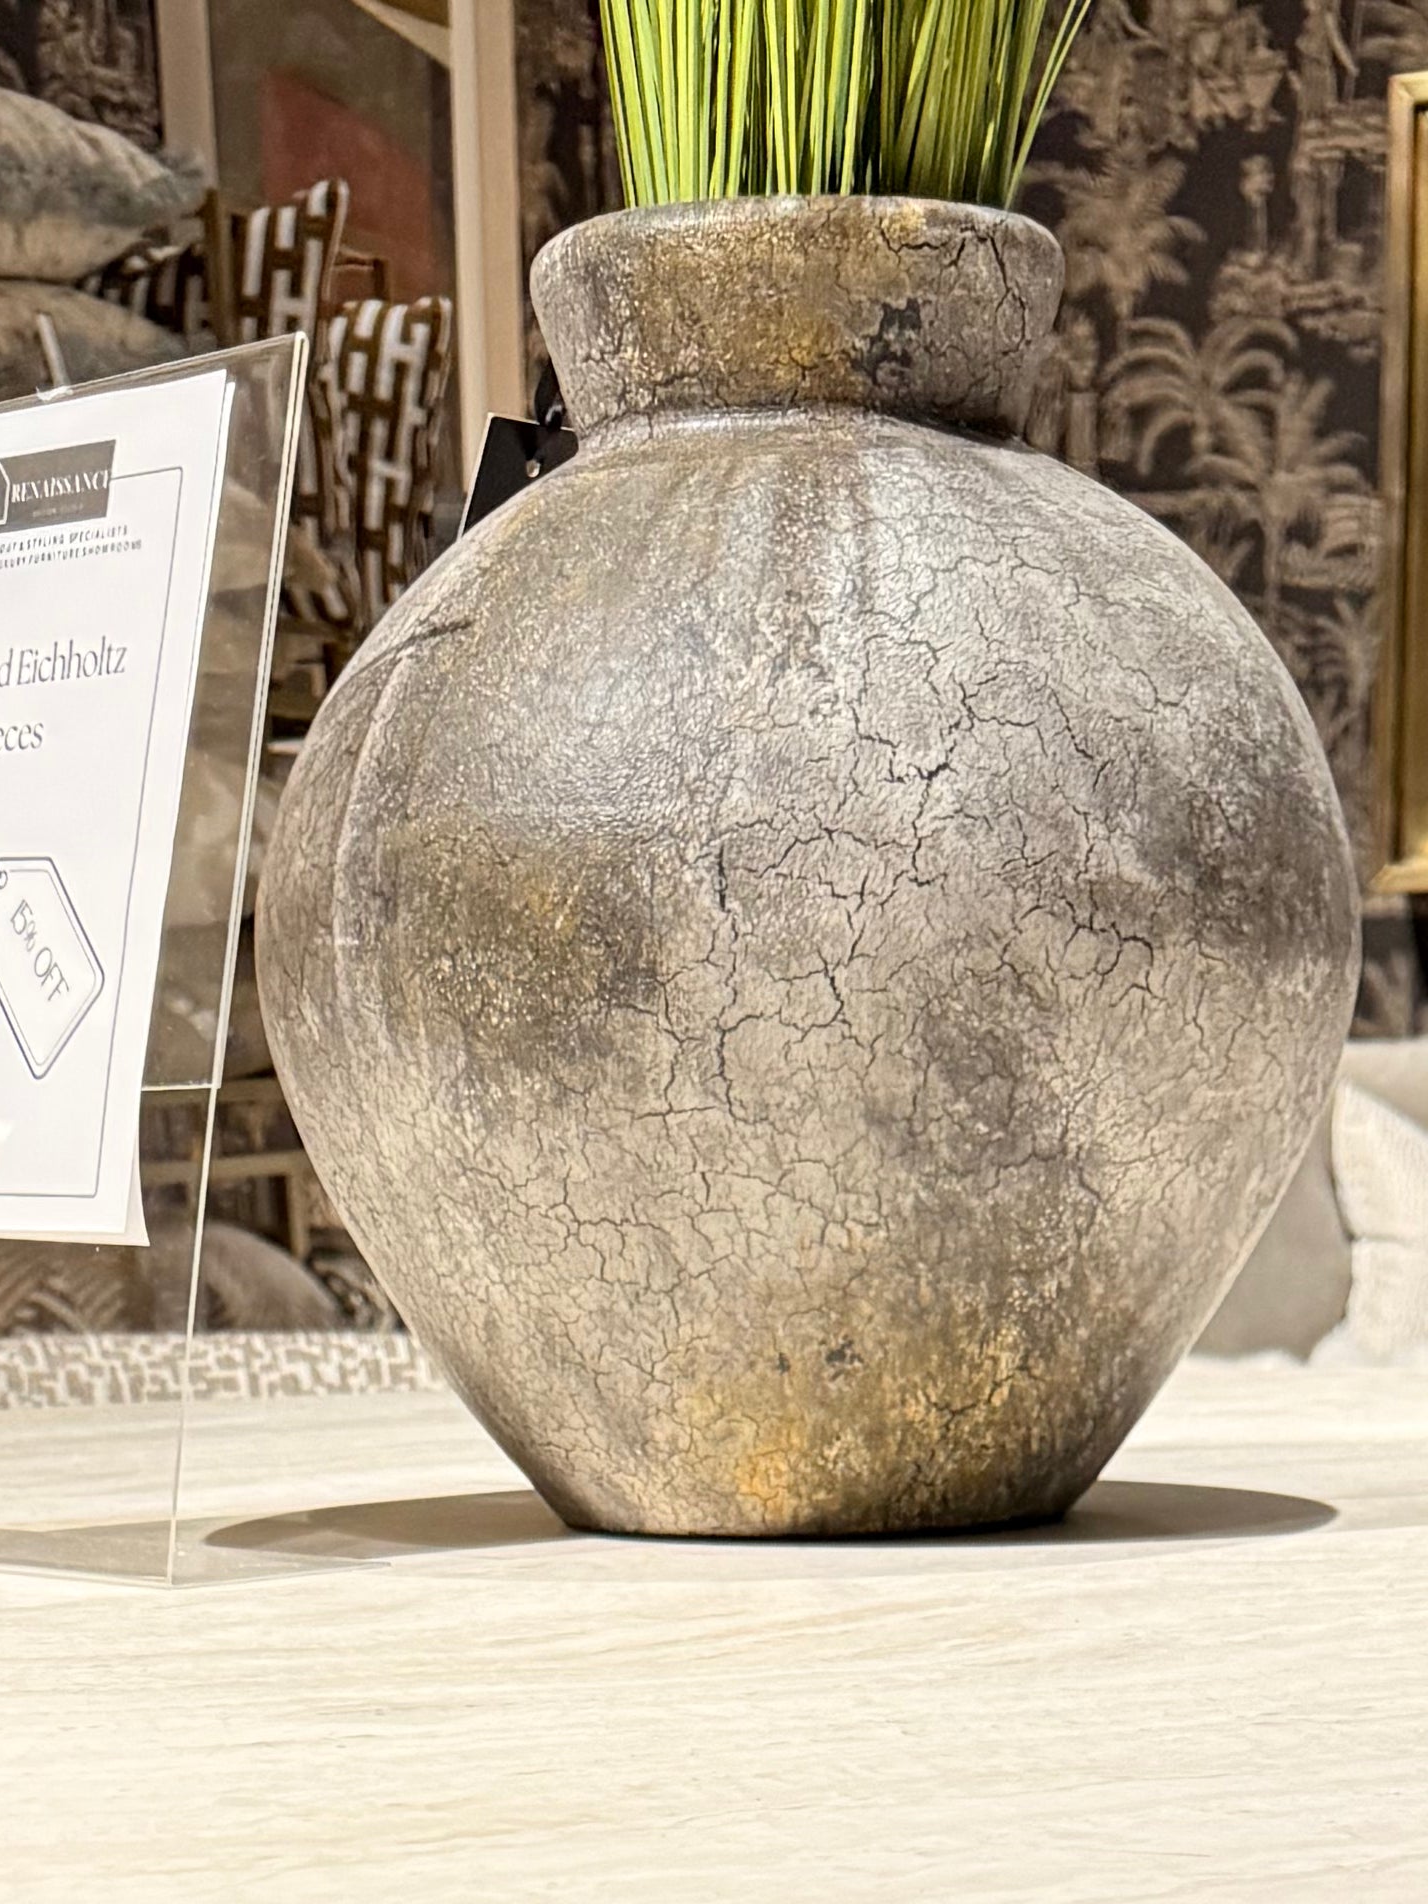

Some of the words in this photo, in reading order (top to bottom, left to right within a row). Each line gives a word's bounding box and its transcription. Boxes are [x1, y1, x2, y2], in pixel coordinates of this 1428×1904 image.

[16, 634, 127, 686] Eichholtz
[10, 899, 38, 953] 15%
[34, 946, 70, 1002] OFF
